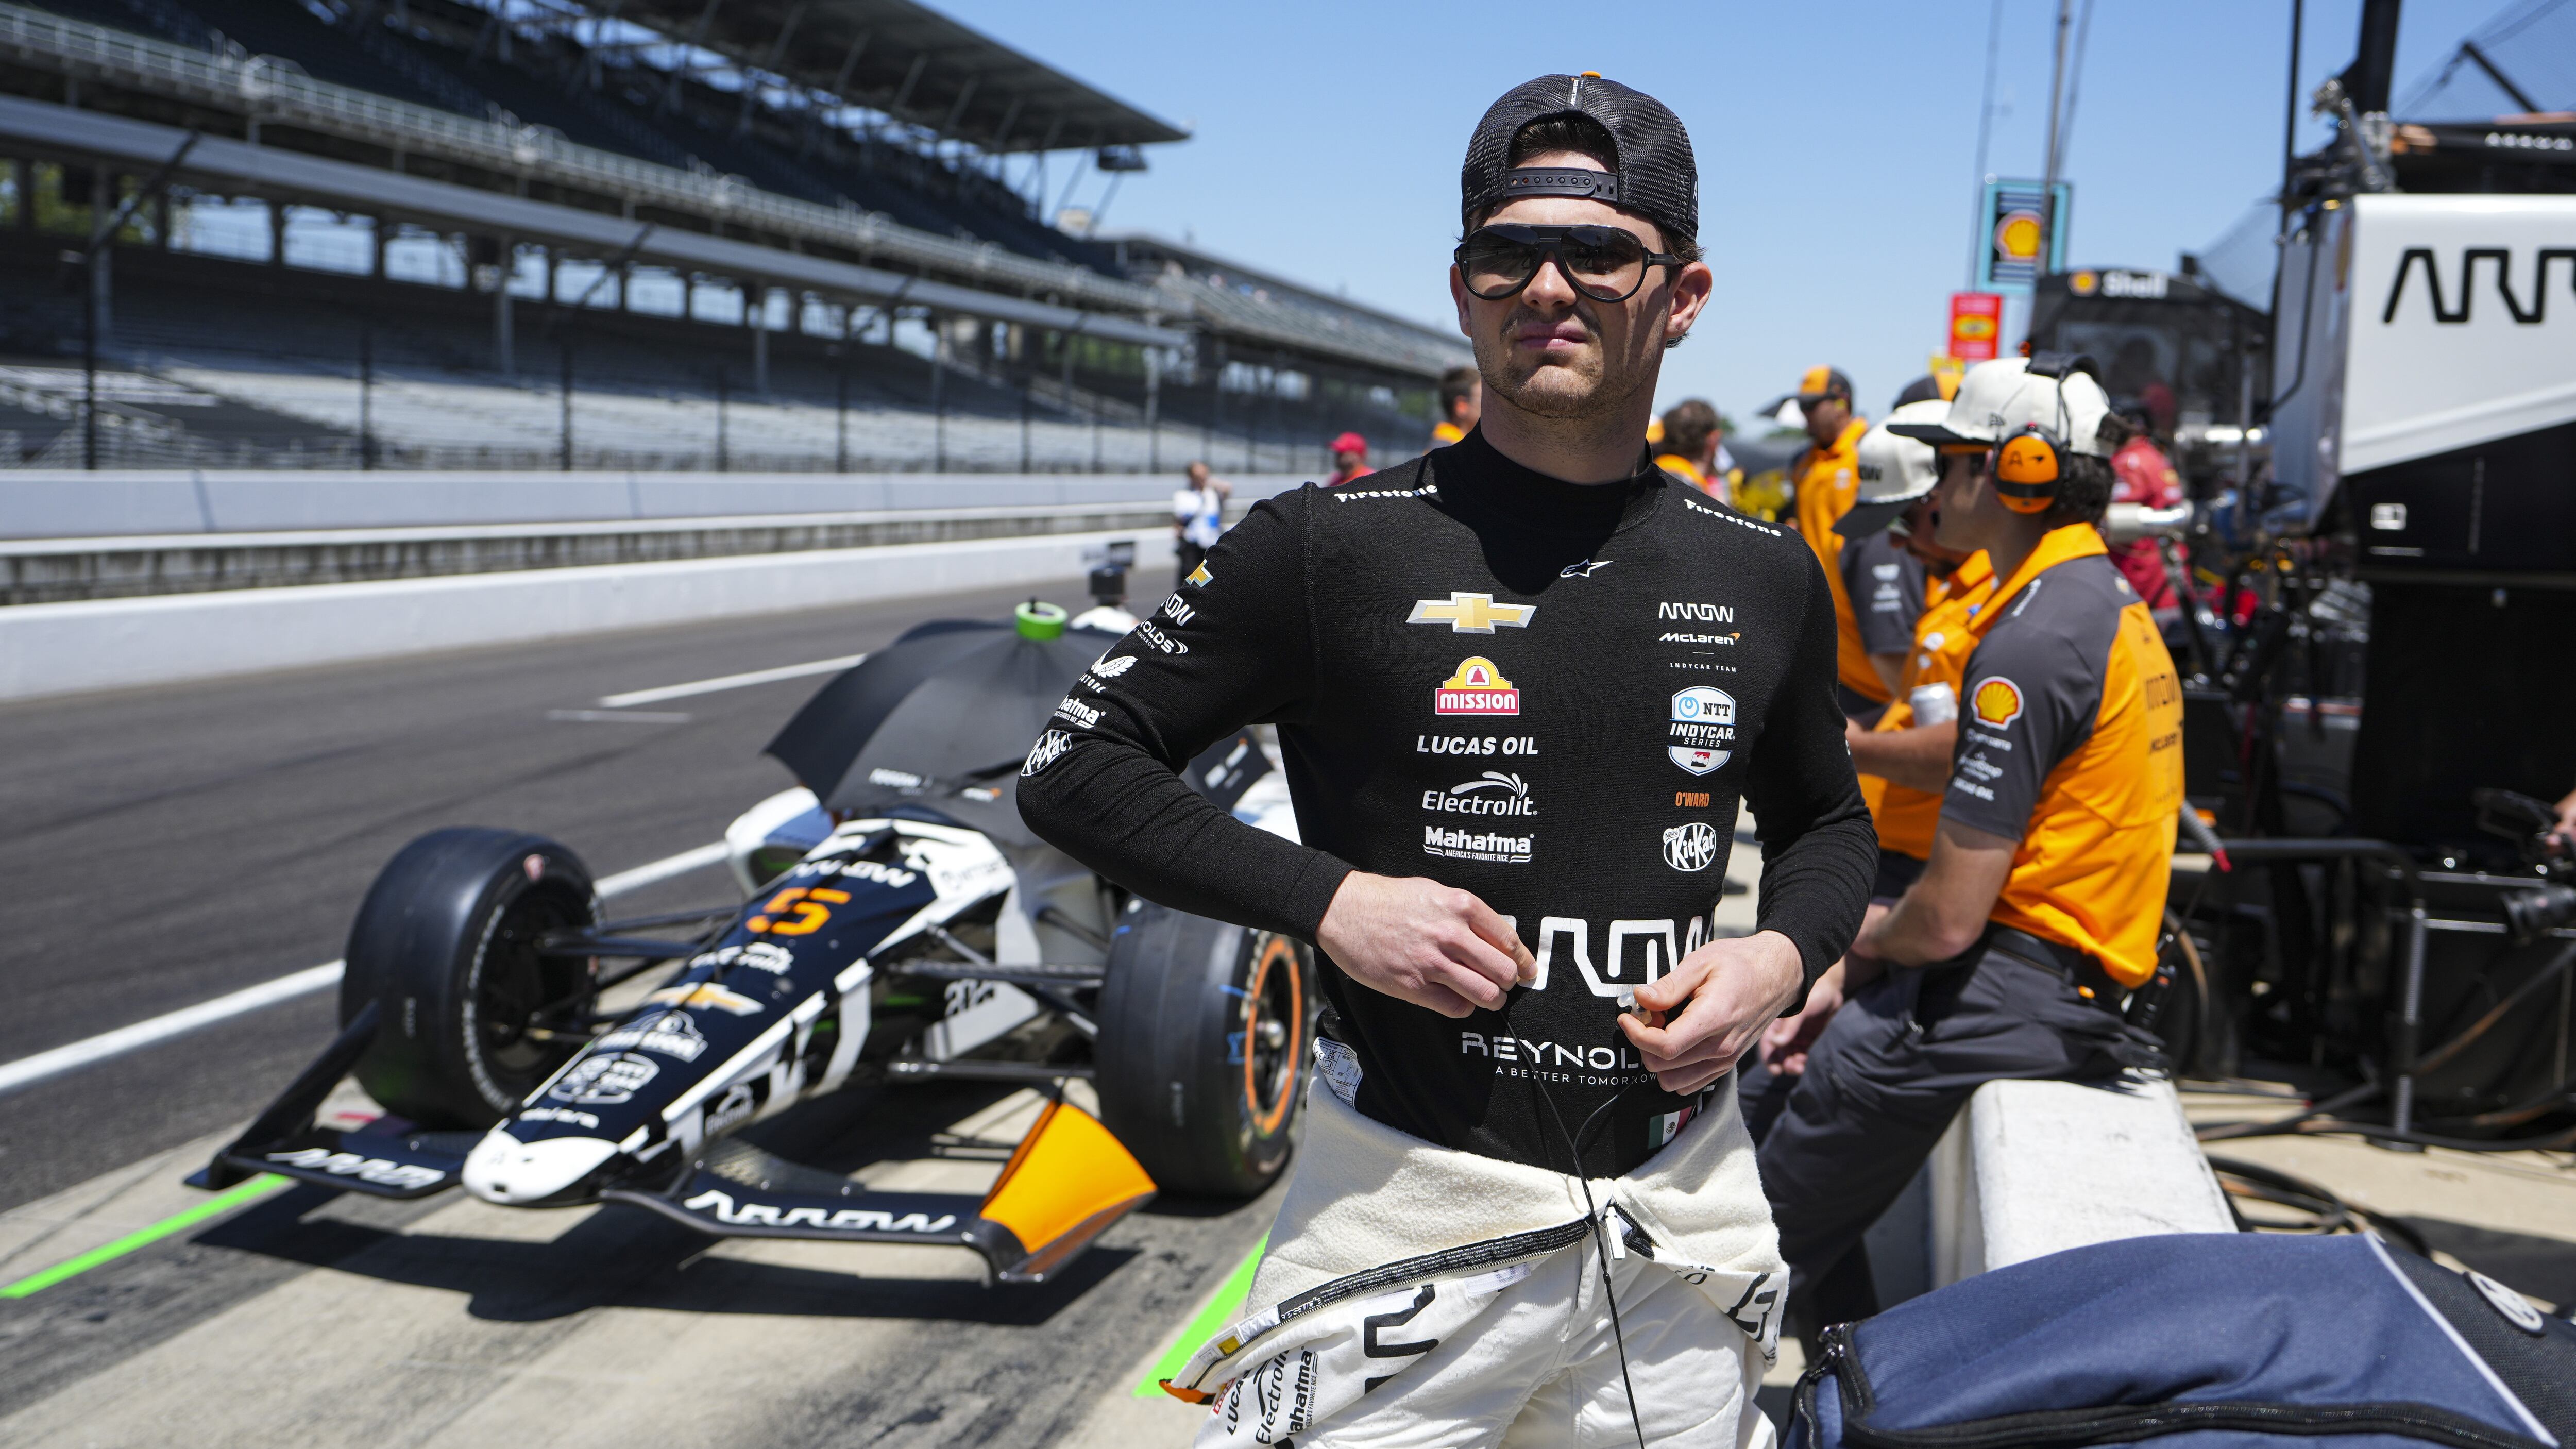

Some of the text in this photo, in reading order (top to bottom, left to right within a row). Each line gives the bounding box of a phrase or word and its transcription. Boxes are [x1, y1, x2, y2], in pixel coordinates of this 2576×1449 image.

[1570, 80, 1579, 106] McLaren
[1626, 235, 1636, 245] FORD
[1334, 484, 1437, 503] Firestone
[1684, 499, 1782, 536] Firestone
[1658, 602, 1733, 623] ARROW
[1658, 632, 1734, 645] McLaren
[1079, 673, 1106, 693] STORE
[1059, 695, 1100, 724] hatma
[1703, 702, 1730, 717] NTT
[1669, 723, 1733, 740] INDYCAR
[1417, 735, 1538, 755] LUCAS OIL
[1684, 737, 1721, 748] SERIES
[1422, 790, 1534, 815] Electrolit
[1675, 791, 1710, 807] O'WARD
[1425, 825, 1531, 853] Mahatma
[1671, 825, 1715, 869] KitKat
[1445, 849, 1509, 862] AMERICA'S FAVORITE RICE
[747, 887, 852, 936] 5
[1462, 1032, 1640, 1070] REYNOL
[1496, 1066, 1657, 1086] A BETTER TOMORROW
[1255, 1350, 1290, 1445] Electroli
[1287, 1351, 1313, 1436] ahatma
[1308, 1386, 1316, 1411] FAVORITE
